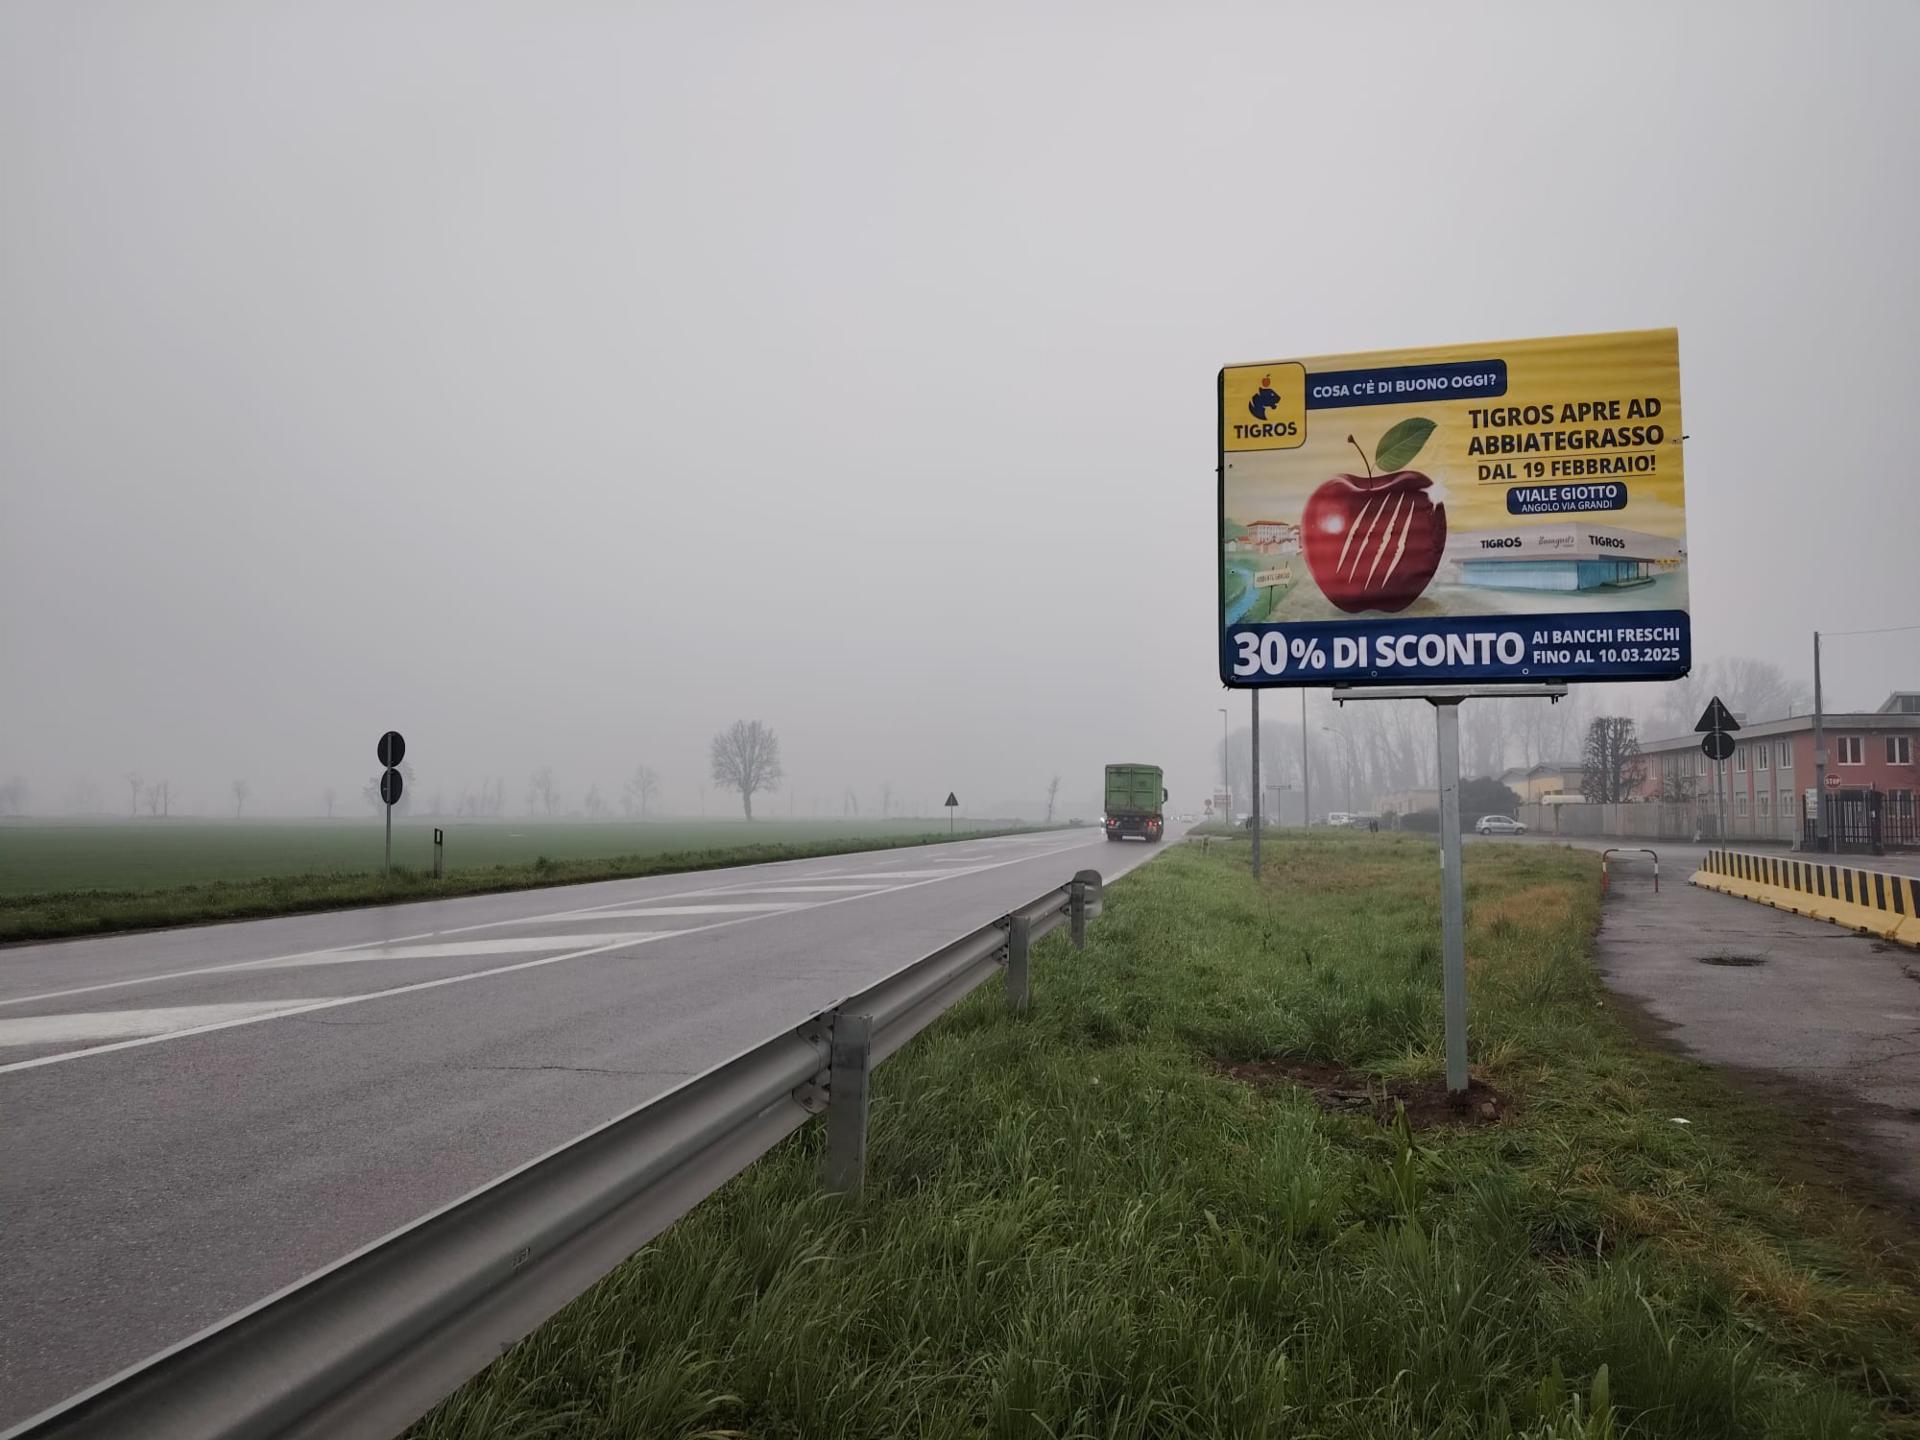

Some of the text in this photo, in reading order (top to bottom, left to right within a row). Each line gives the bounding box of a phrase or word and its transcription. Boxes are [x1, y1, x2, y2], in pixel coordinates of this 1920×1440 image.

[1313, 385, 1349, 399] COSA
[1378, 381, 1393, 394] DI
[1396, 378, 1448, 393] BUONO
[1451, 374, 1497, 390] OGGI?
[1468, 397, 1662, 427] TIGROS APRE AD
[1233, 421, 1298, 439] TIGROS
[1468, 424, 1665, 456] ABBIATEGRASSO
[1478, 454, 1656, 481] DAL 19 FEBBRAIO!
[1516, 485, 1618, 503] VIALE GIOTTO
[1521, 499, 1613, 513] ANGOLO VIA GRANDI
[1480, 536, 1522, 549] TIGROS
[1588, 534, 1626, 549] TIGROS
[1532, 627, 1680, 645] AI BANCHI FRESCHI
[1233, 630, 1525, 677] 30% DI SCONTO
[1533, 647, 1680, 664] FINO AL 10.03.2025
